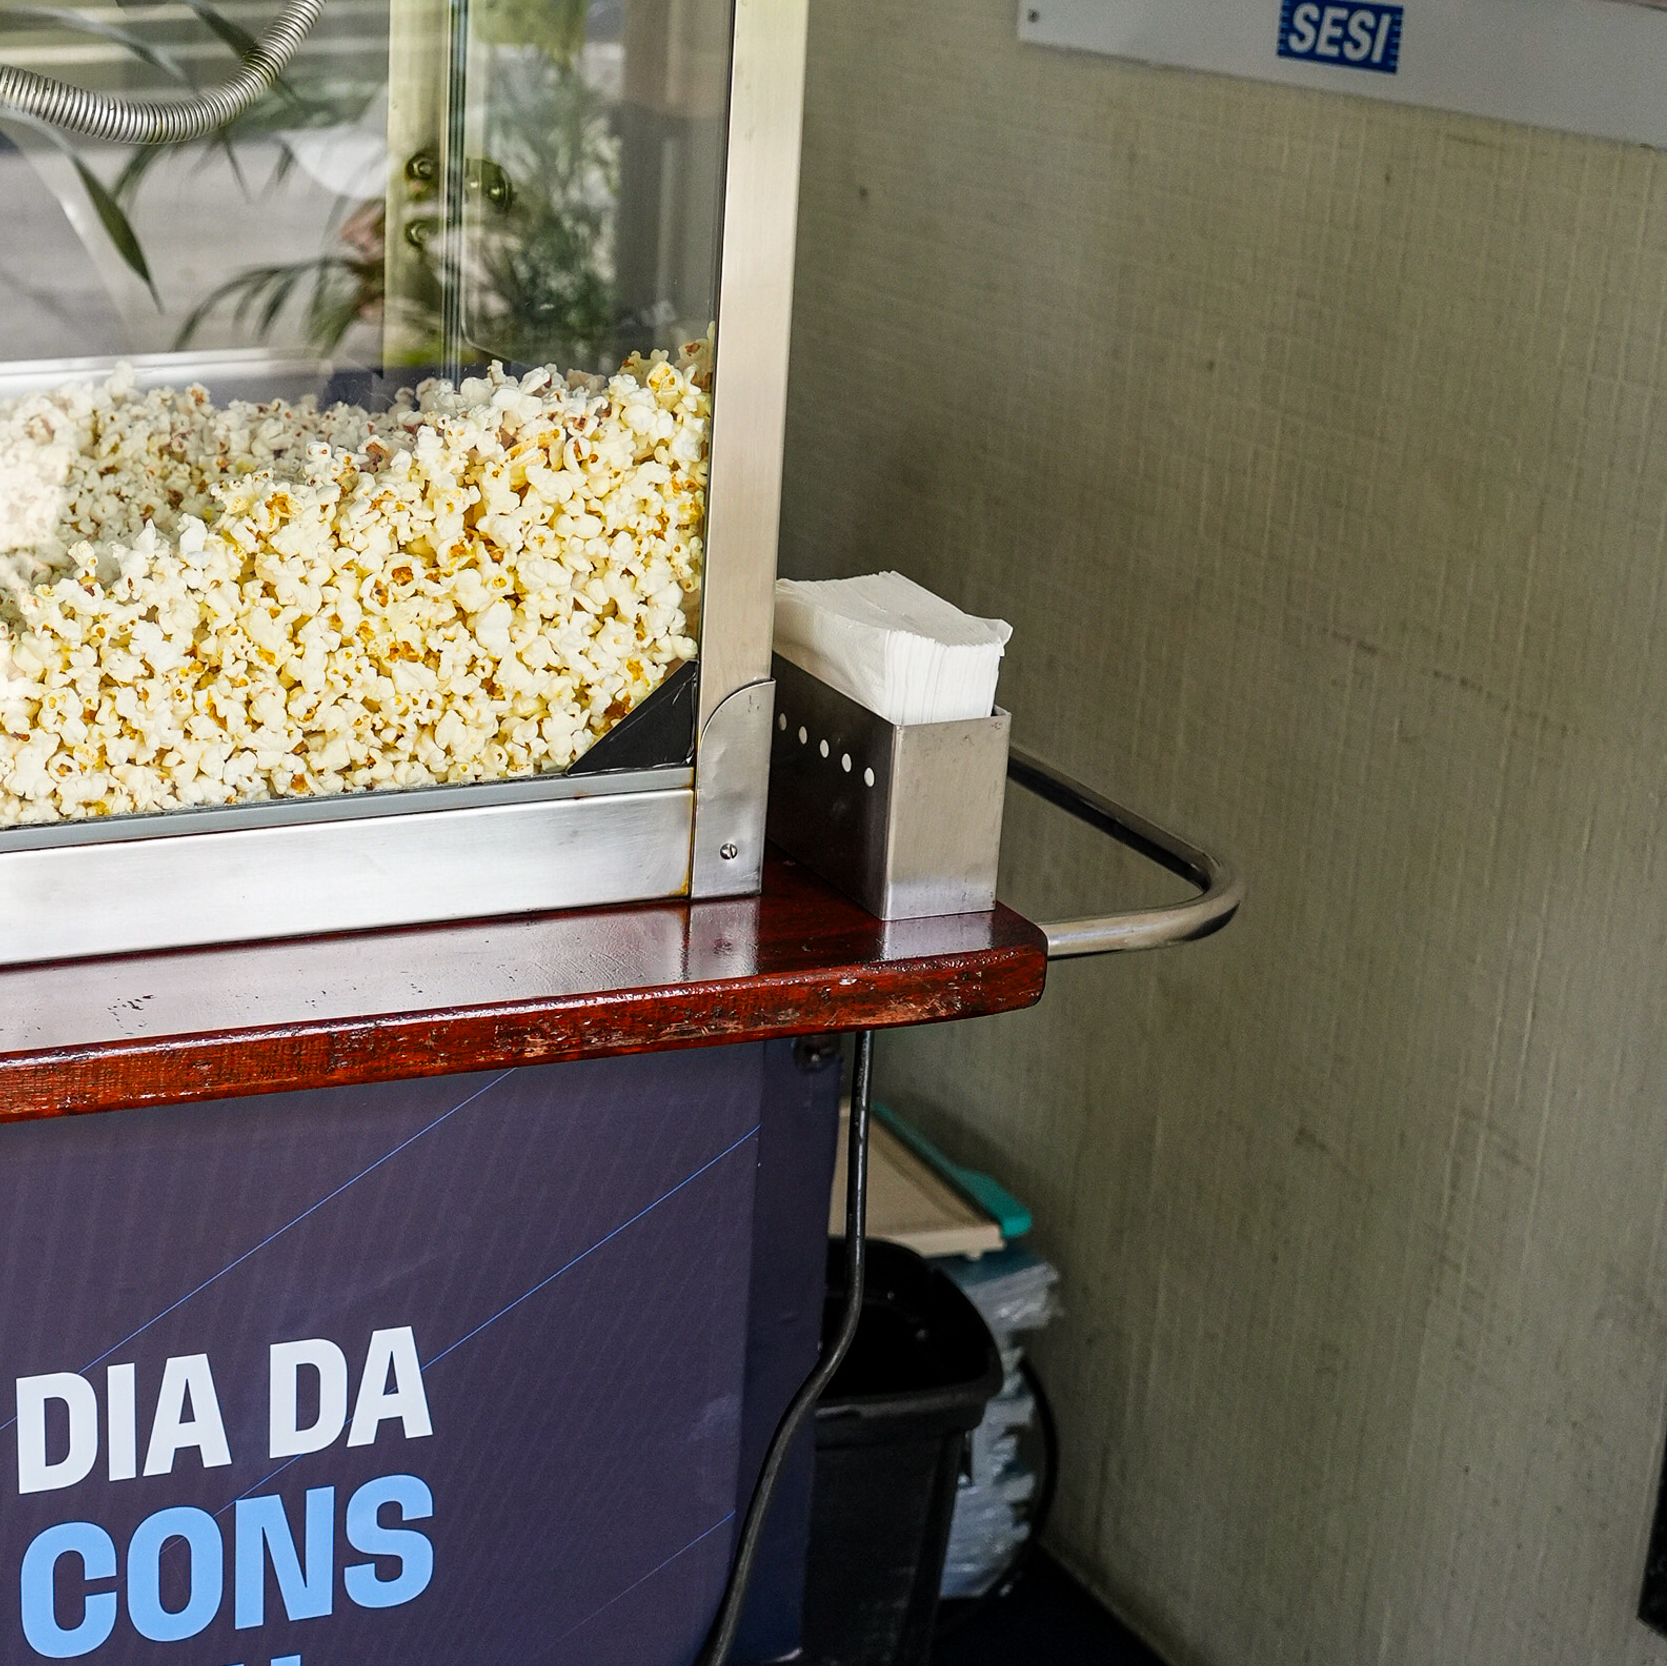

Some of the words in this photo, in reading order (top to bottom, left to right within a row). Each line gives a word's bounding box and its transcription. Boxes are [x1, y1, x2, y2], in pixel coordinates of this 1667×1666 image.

[1288, 2, 1390, 65] SESI
[17, 1354, 232, 1495] DIA
[270, 1326, 434, 1460] DA
[20, 1473, 434, 1659] CONS
